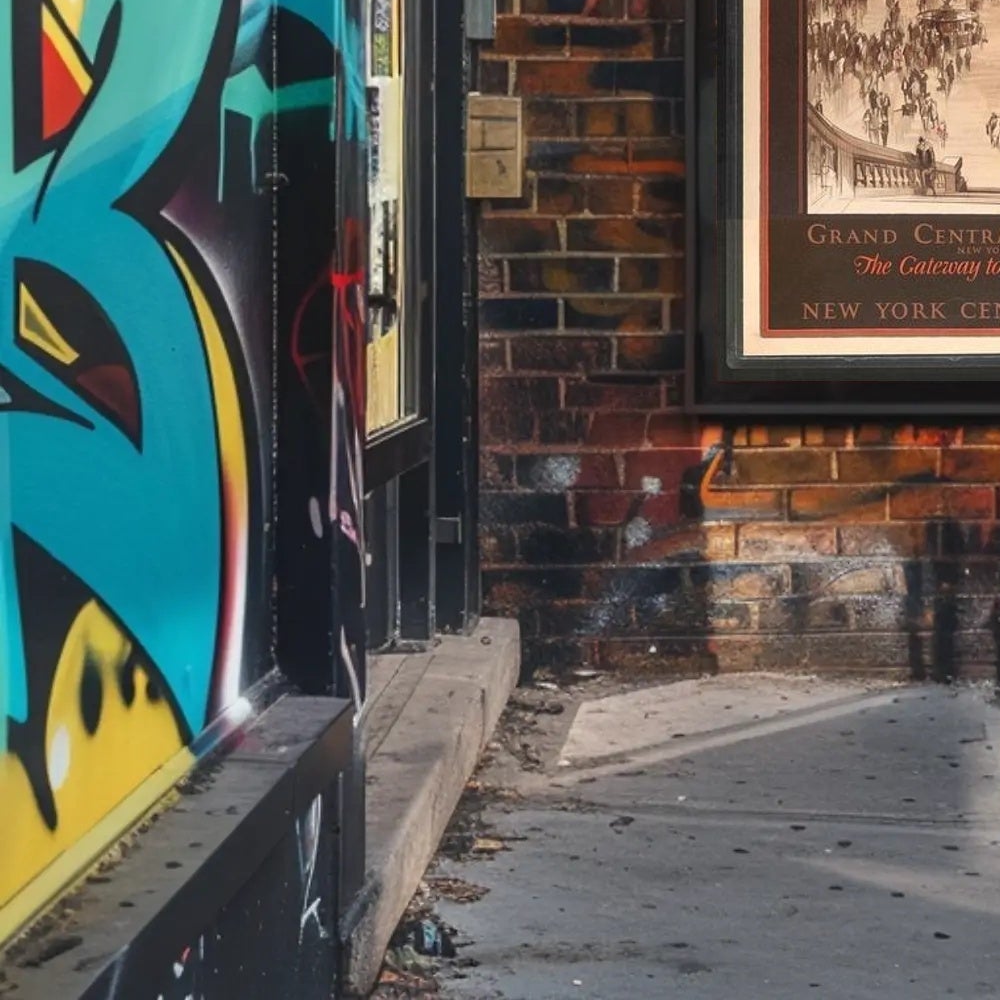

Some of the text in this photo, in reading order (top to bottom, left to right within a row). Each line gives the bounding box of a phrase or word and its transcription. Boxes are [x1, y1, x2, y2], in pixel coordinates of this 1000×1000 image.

[957, 246, 981, 254] NEW
[854, 253, 892, 275] The
[899, 255, 980, 281] Gateway
[802, 302, 862, 320] NEW
[876, 302, 946, 320] YORK
